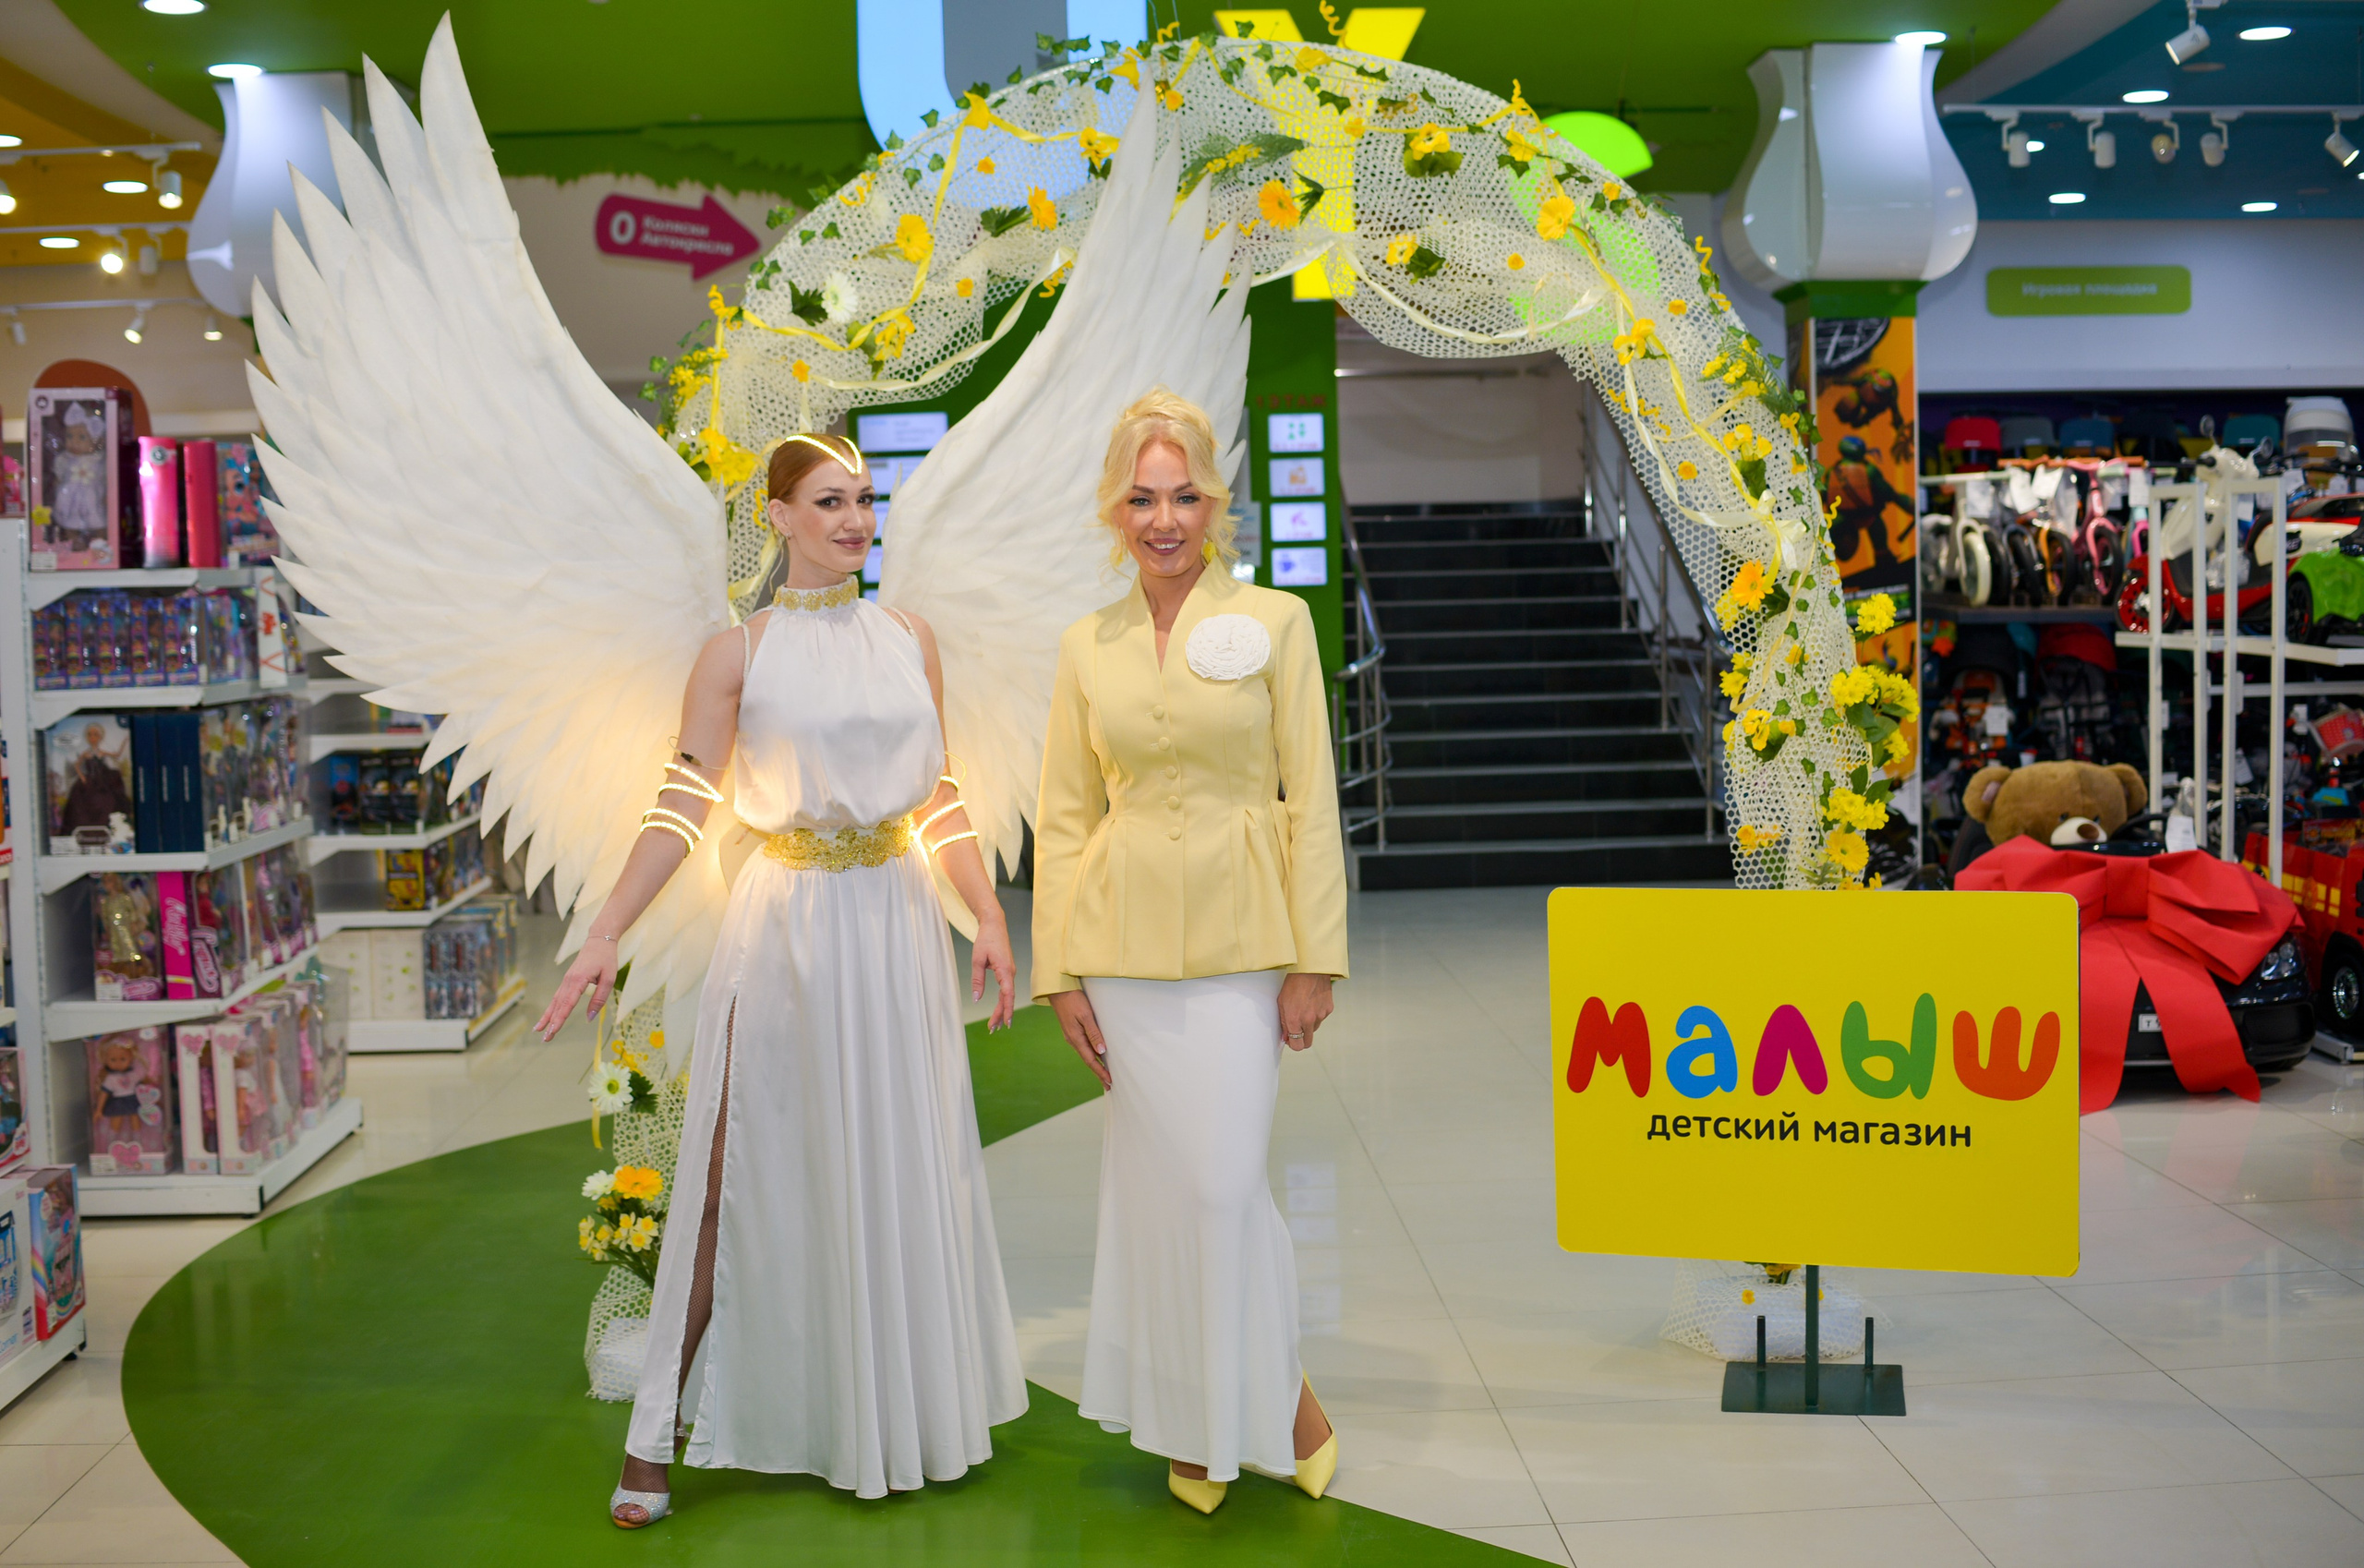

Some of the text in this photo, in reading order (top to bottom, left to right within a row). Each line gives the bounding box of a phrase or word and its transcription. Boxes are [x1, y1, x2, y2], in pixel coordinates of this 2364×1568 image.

[643, 215, 709, 236] Коляски
[640, 231, 734, 256] Автокресла
[1647, 1112, 1971, 1147] детский магазин
